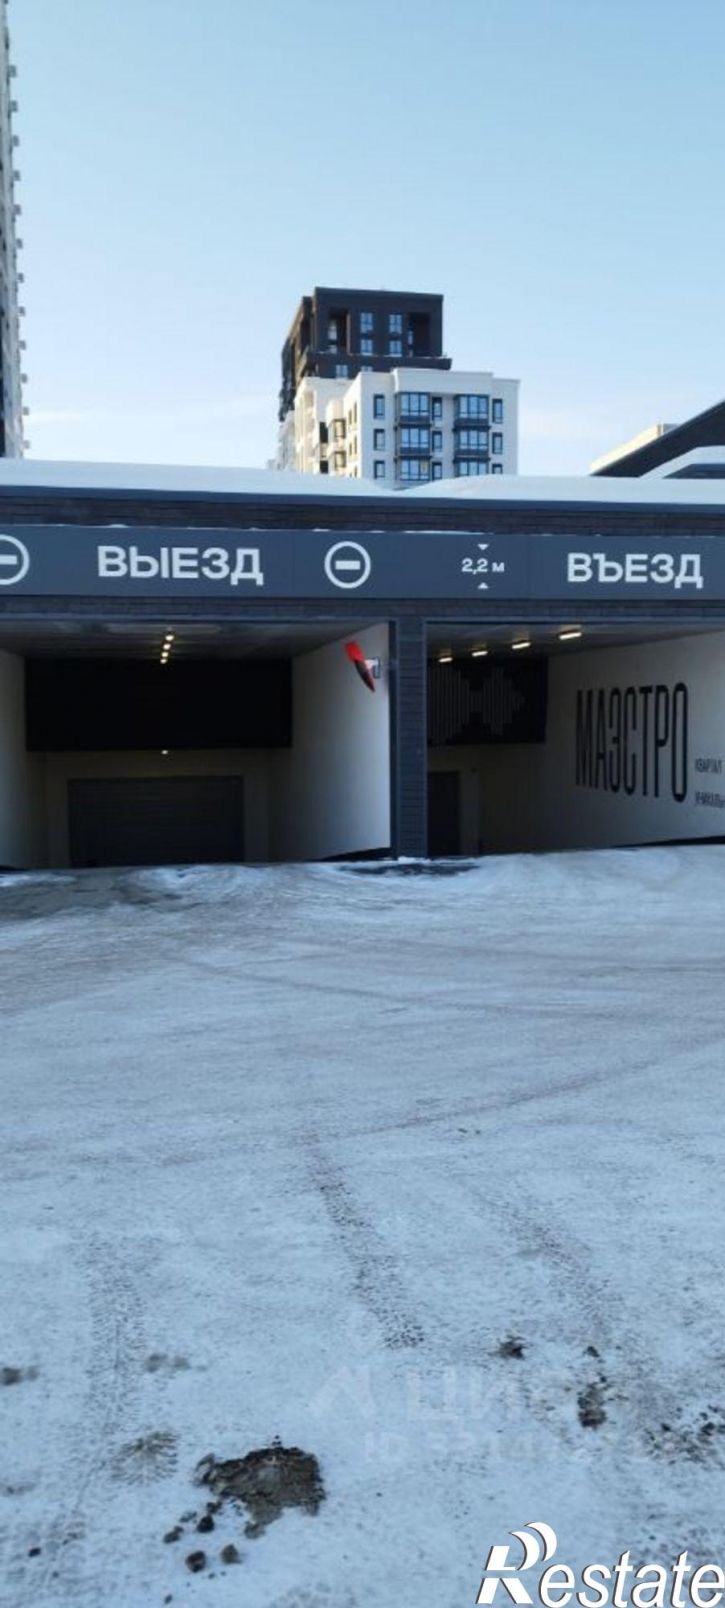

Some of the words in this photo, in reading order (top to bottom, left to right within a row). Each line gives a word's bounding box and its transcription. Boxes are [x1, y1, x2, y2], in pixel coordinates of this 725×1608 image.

[96, 545, 264, 585] ВЫЕЗД
[461, 558, 489, 575] 2,2
[567, 552, 703, 589] ВЪЕЗД
[575, 682, 688, 803] МАЭСТРО
